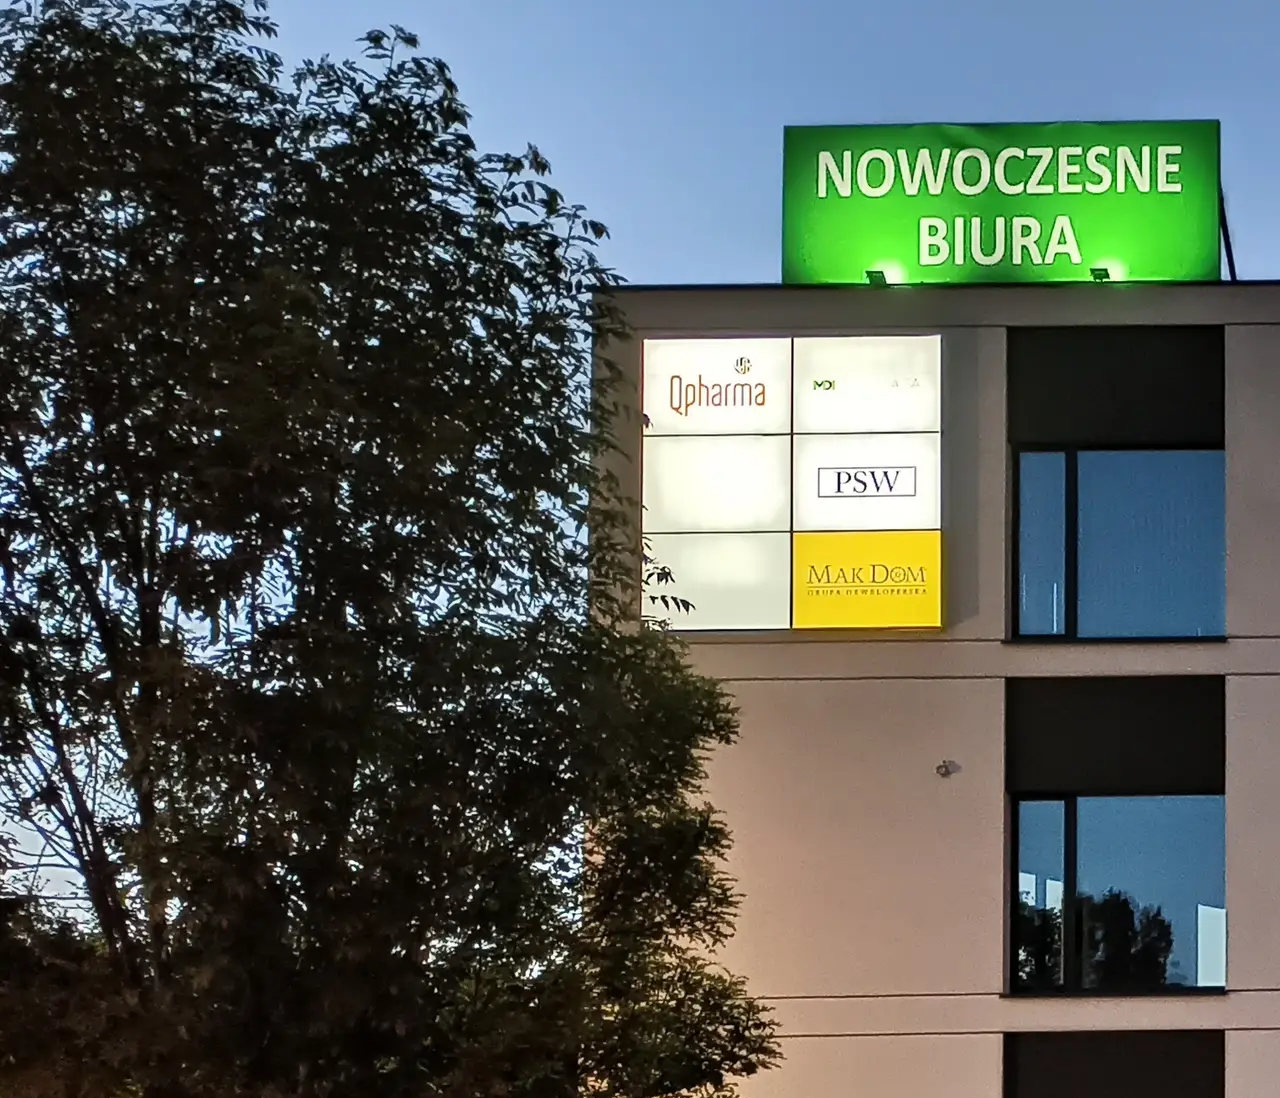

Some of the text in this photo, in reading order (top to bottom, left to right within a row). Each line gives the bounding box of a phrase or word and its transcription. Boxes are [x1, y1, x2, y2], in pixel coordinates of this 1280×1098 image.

[817, 144, 1183, 199] NOWOCZESNE
[918, 214, 1083, 266] BIURA
[669, 374, 766, 417] Qpharma
[833, 470, 902, 494] PSW
